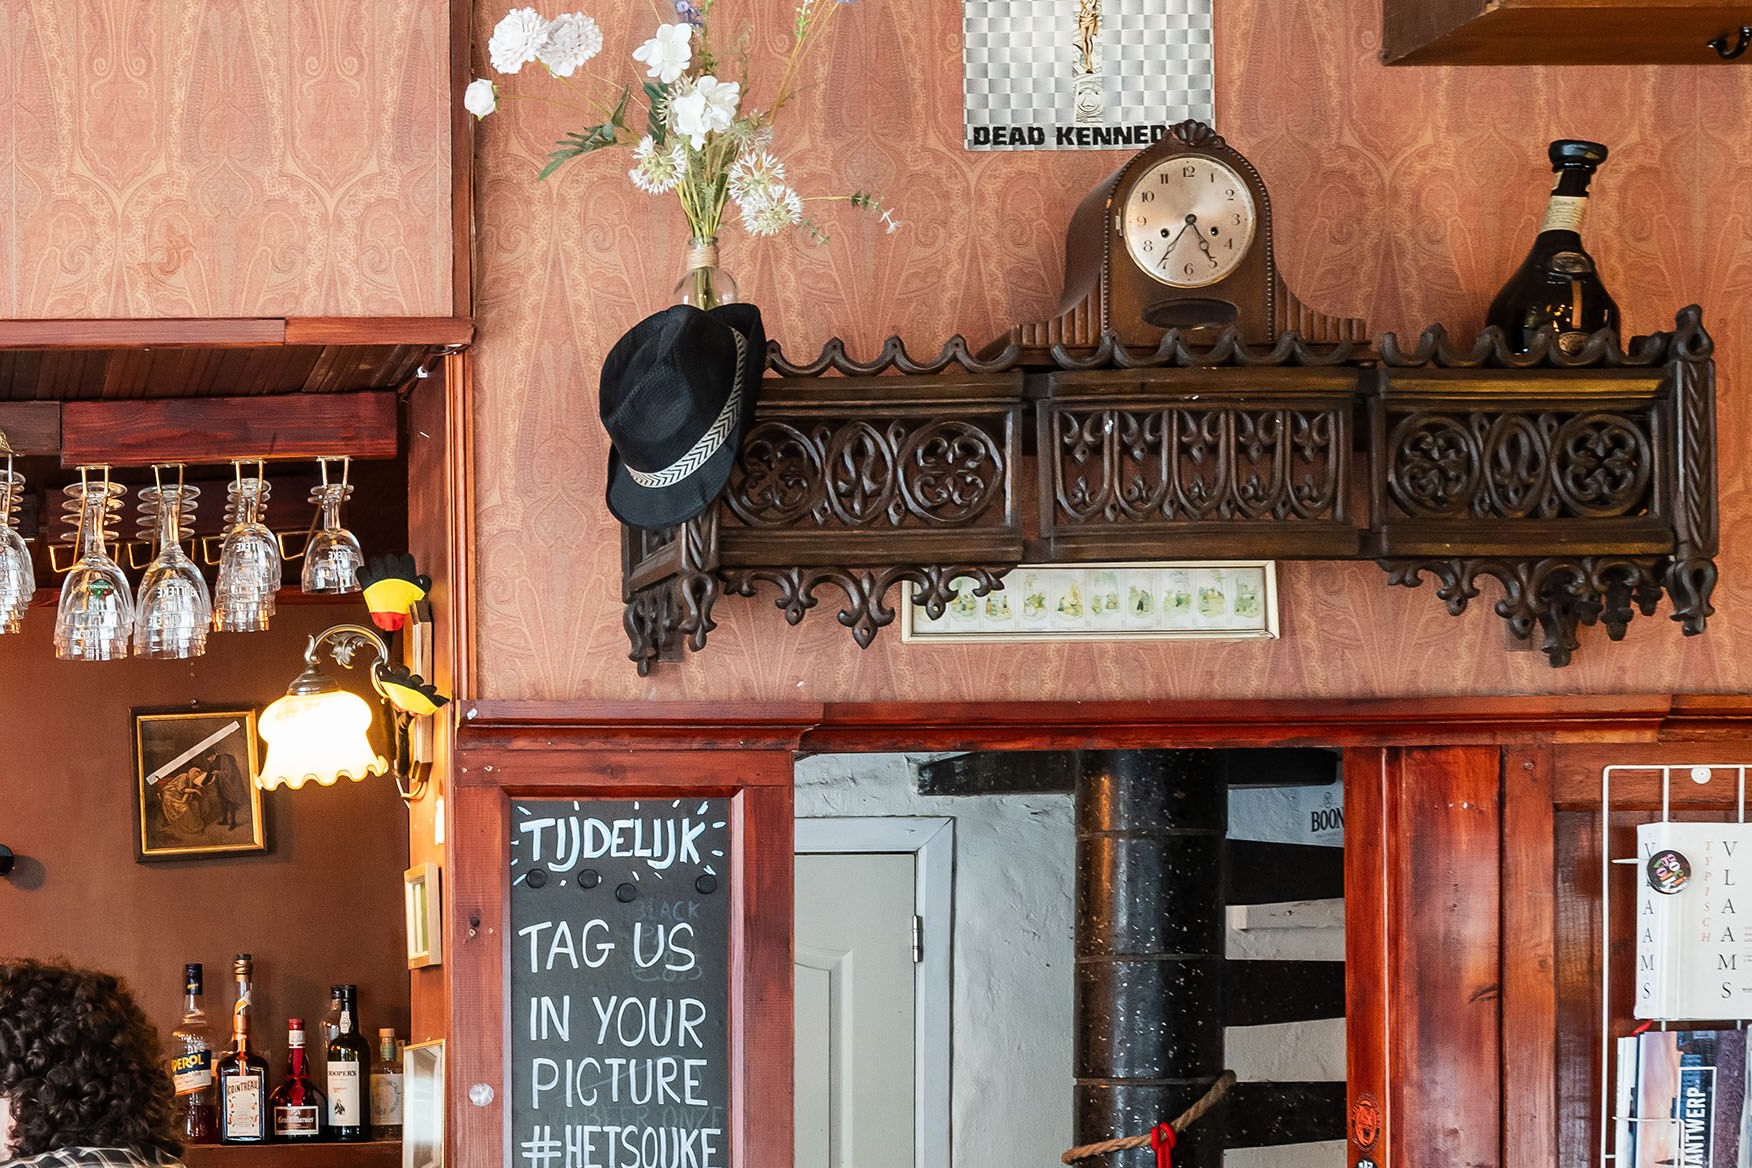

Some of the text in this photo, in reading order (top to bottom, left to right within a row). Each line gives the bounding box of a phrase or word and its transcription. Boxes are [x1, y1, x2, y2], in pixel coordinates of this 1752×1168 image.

[973, 124, 1178, 146] DEAD KENNED
[1182, 165, 1195, 177] 12
[1209, 172, 1214, 183] 1
[1160, 173, 1169, 184] 11
[1141, 190, 1155, 203] 10
[1225, 188, 1235, 201] 2
[1137, 216, 1147, 226] 9
[1231, 213, 1241, 226] 3
[1143, 239, 1153, 252] 8
[1224, 238, 1233, 250] 4
[1184, 262, 1194, 275] 6
[1208, 256, 1218, 269] 5
[519, 816, 706, 872] TIJDELIJK
[1701, 841, 1713, 943] TYPISCH
[1640, 842, 1656, 1000] VAAMS
[1717, 841, 1738, 999] VLAAMS
[519, 918, 696, 974] TAG US
[530, 995, 707, 1048] IN YOUR
[228, 1080, 259, 1095] COINTREAU
[532, 1057, 708, 1110] PICTURE
